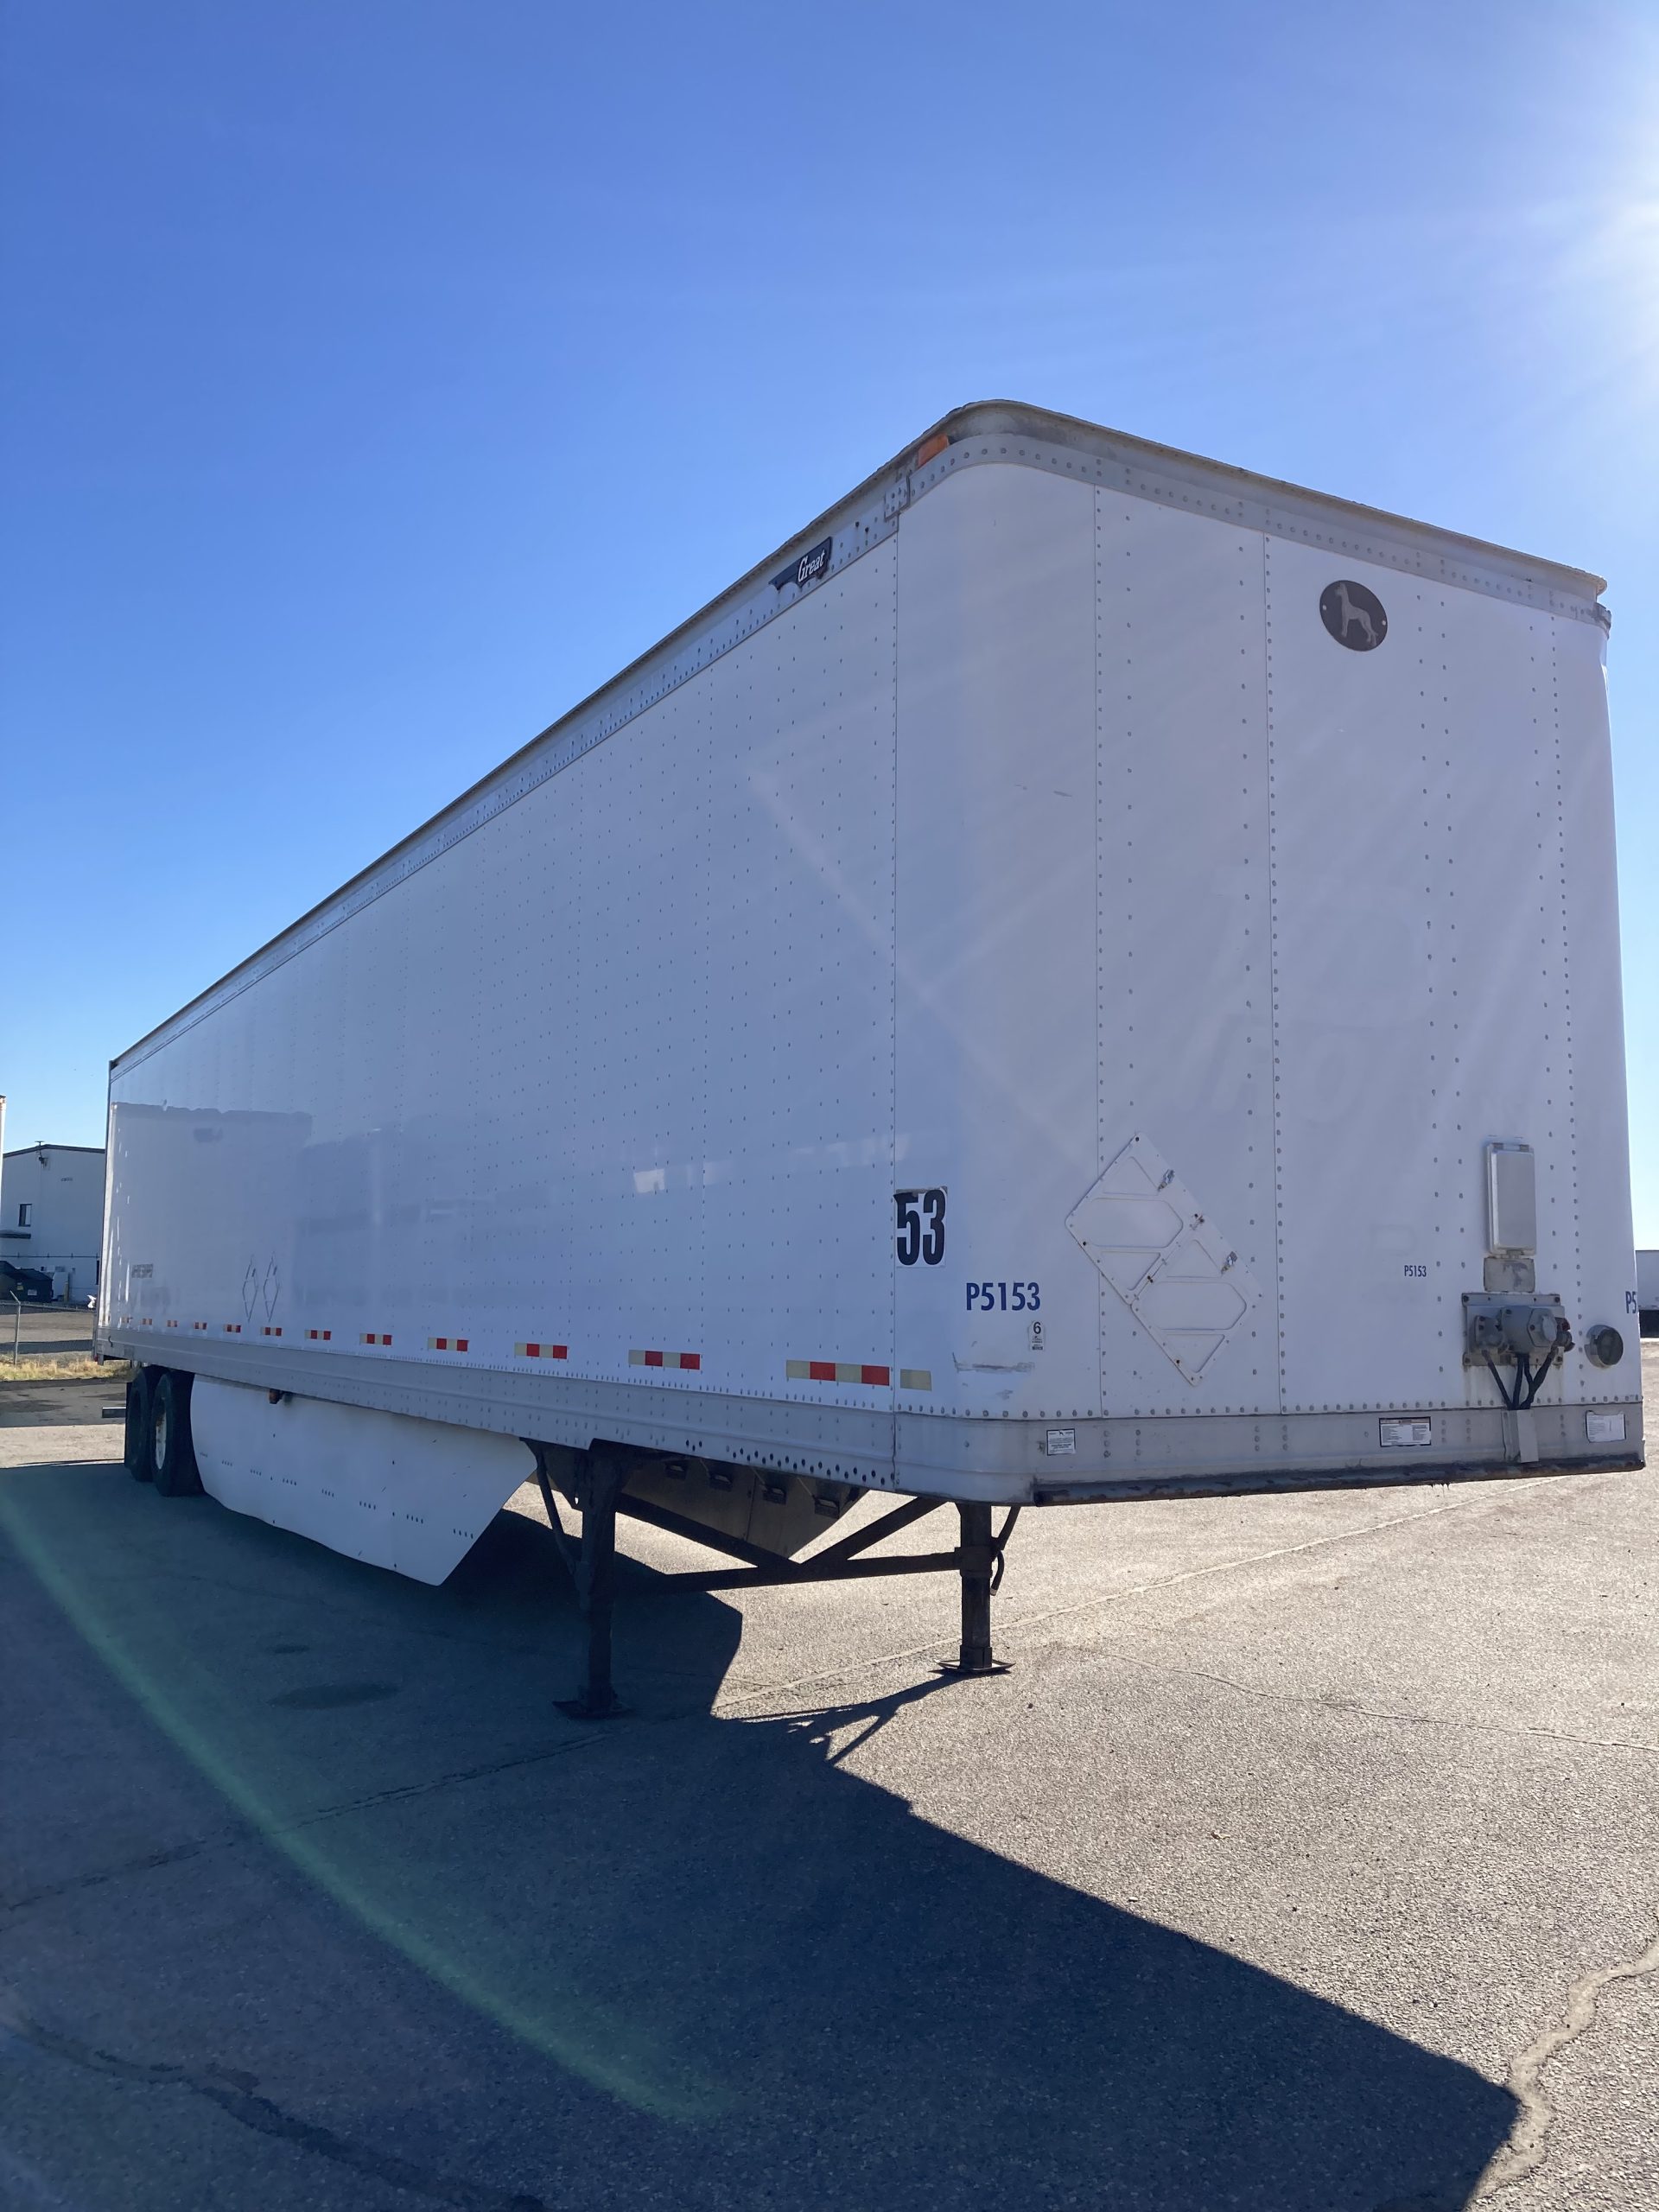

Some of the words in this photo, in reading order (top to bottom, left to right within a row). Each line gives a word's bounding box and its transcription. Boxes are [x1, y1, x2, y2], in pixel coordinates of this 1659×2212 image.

[798, 550, 825, 582] Great
[893, 1189, 945, 1266] 53
[1404, 1265, 1427, 1277] P5153
[966, 1282, 1040, 1311] P5153
[1033, 1321, 1042, 1334] 6
